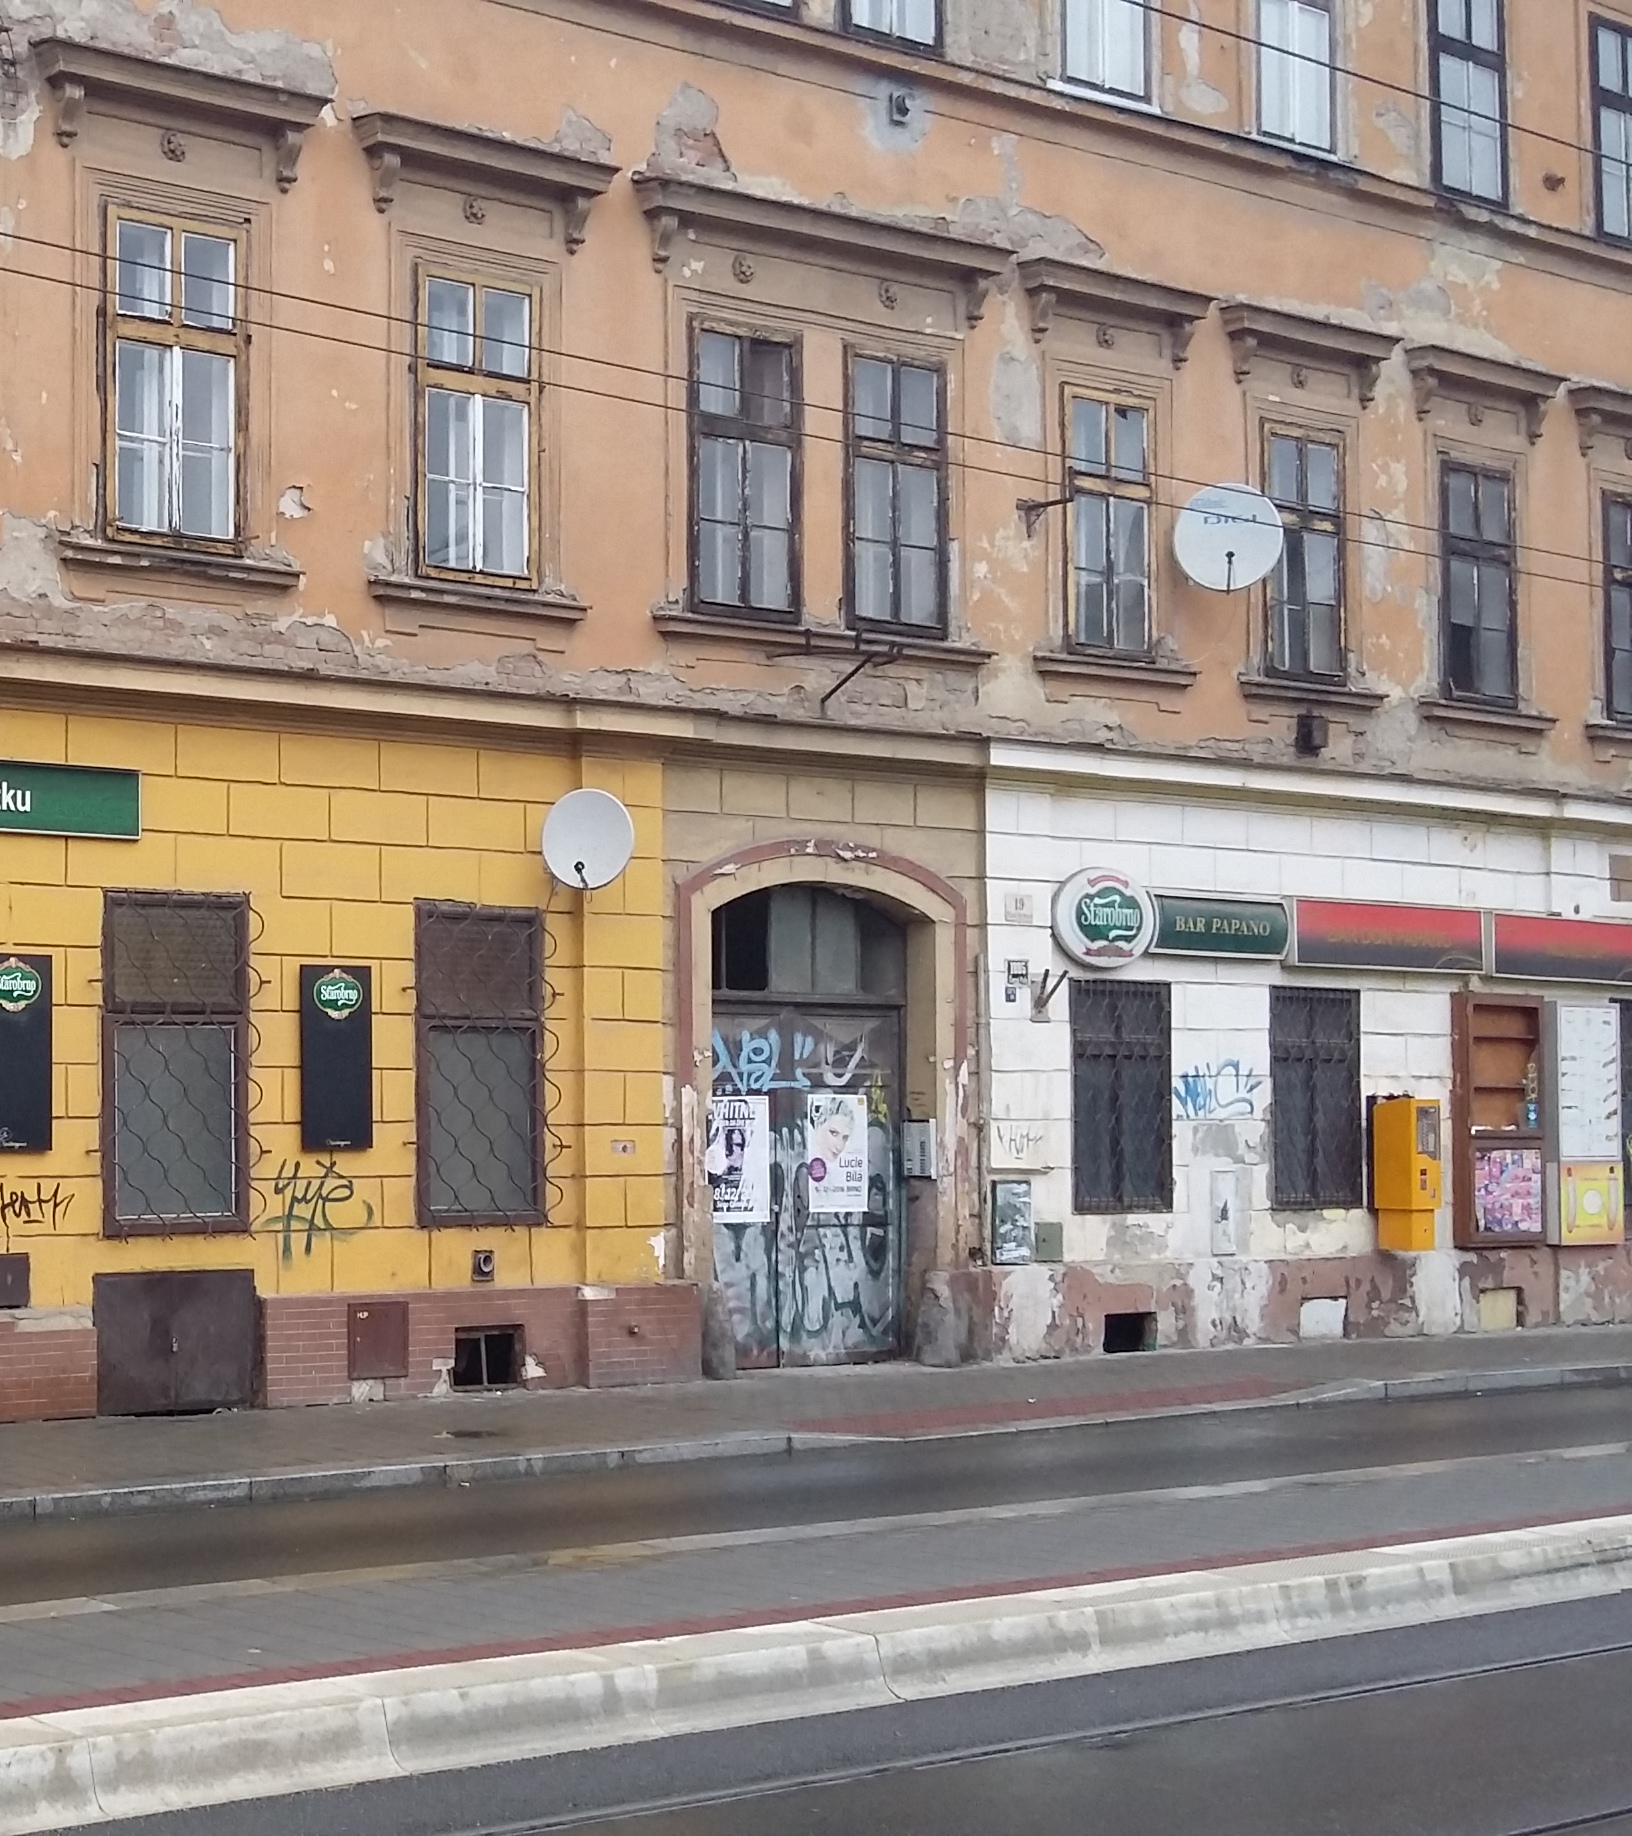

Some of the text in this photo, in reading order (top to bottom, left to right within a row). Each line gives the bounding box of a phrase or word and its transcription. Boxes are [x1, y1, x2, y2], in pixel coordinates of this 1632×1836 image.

[1081, 894, 1140, 940] Starobrno
[1175, 915, 1272, 937] BAR PAPANO
[320, 982, 358, 1006] Starobrno
[839, 1156, 863, 1168] Lucie
